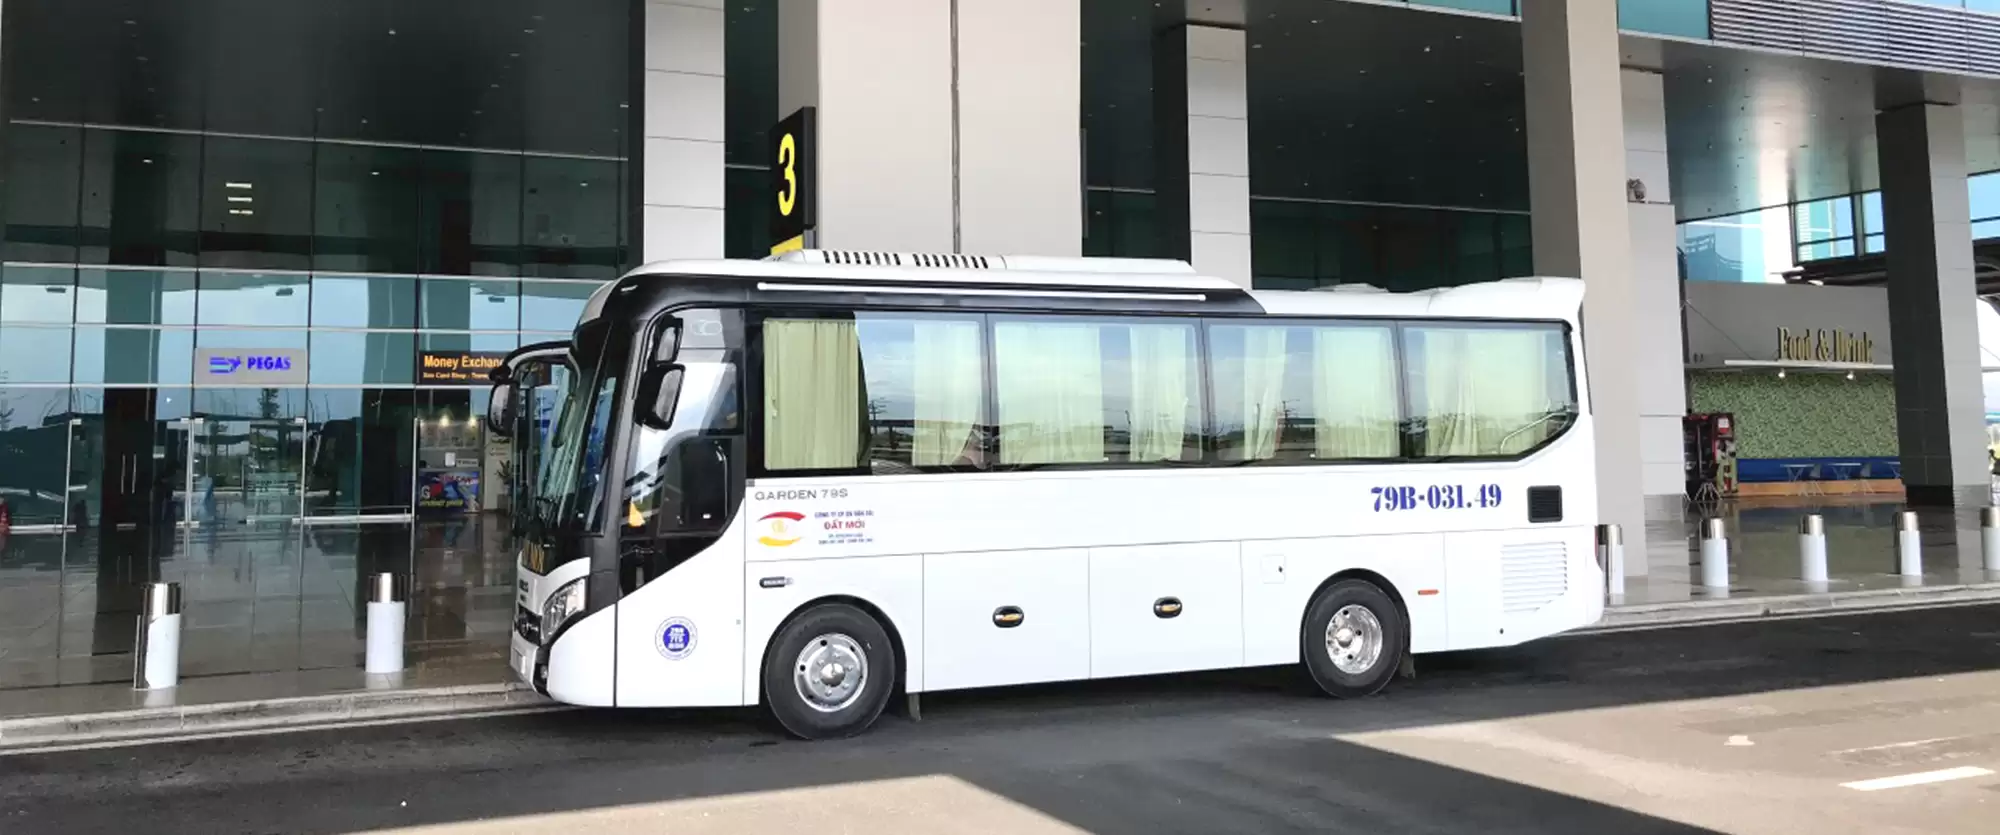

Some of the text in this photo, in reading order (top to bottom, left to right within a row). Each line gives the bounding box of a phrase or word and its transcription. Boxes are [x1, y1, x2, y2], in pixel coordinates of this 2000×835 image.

[778, 133, 797, 216] 3
[1777, 326, 1873, 363] Food & Drink
[247, 356, 291, 370] PEGAS
[424, 355, 504, 370] Money Exchan
[755, 489, 817, 501] GARDEN
[1371, 484, 1502, 512] 79B-031.49
